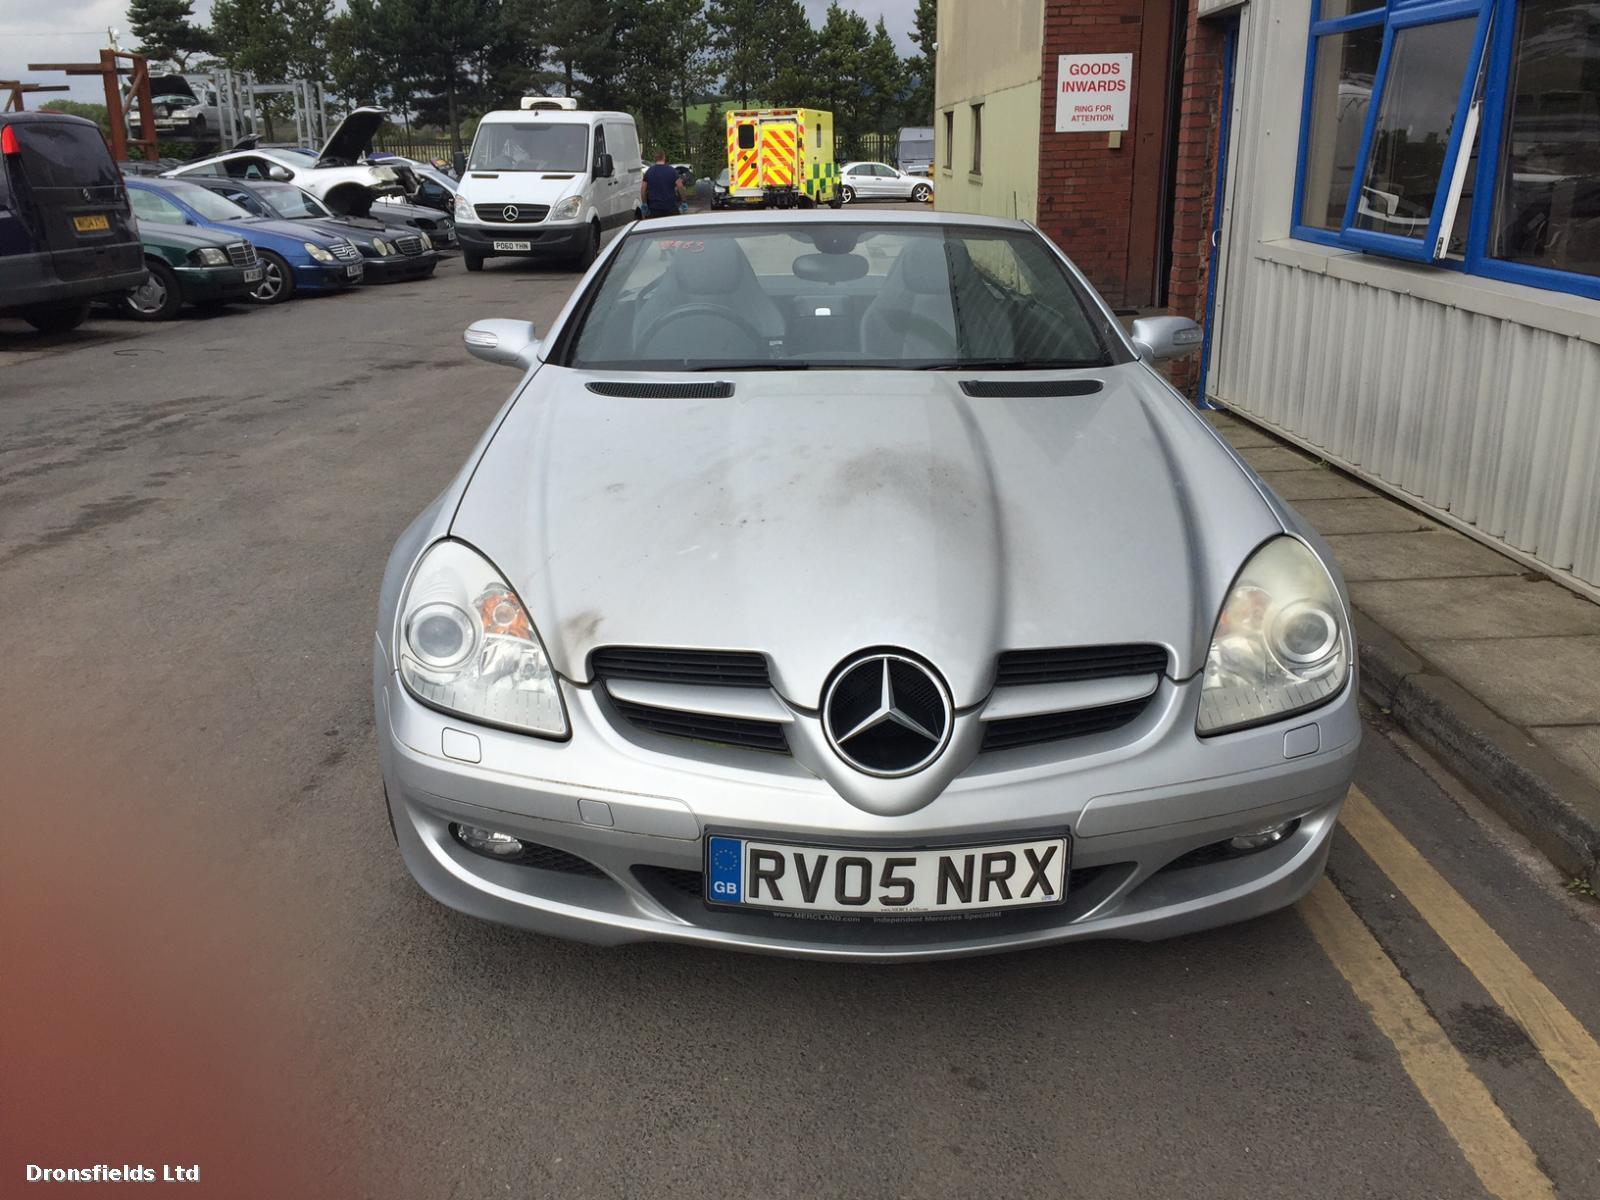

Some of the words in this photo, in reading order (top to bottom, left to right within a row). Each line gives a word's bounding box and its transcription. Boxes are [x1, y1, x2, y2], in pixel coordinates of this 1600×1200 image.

[1069, 63, 1121, 76] GOODS
[1062, 79, 1126, 93] INWARDS
[1074, 105, 1093, 113] RING
[1095, 104, 1112, 112] FOR
[1071, 114, 1114, 122] ATTENTION
[748, 848, 916, 906] RV05
[936, 846, 1058, 905] NRX
[714, 881, 737, 894] GB
[873, 915, 922, 924] Independent
[924, 914, 961, 922] Mercedes
[964, 911, 1002, 920] Specialist
